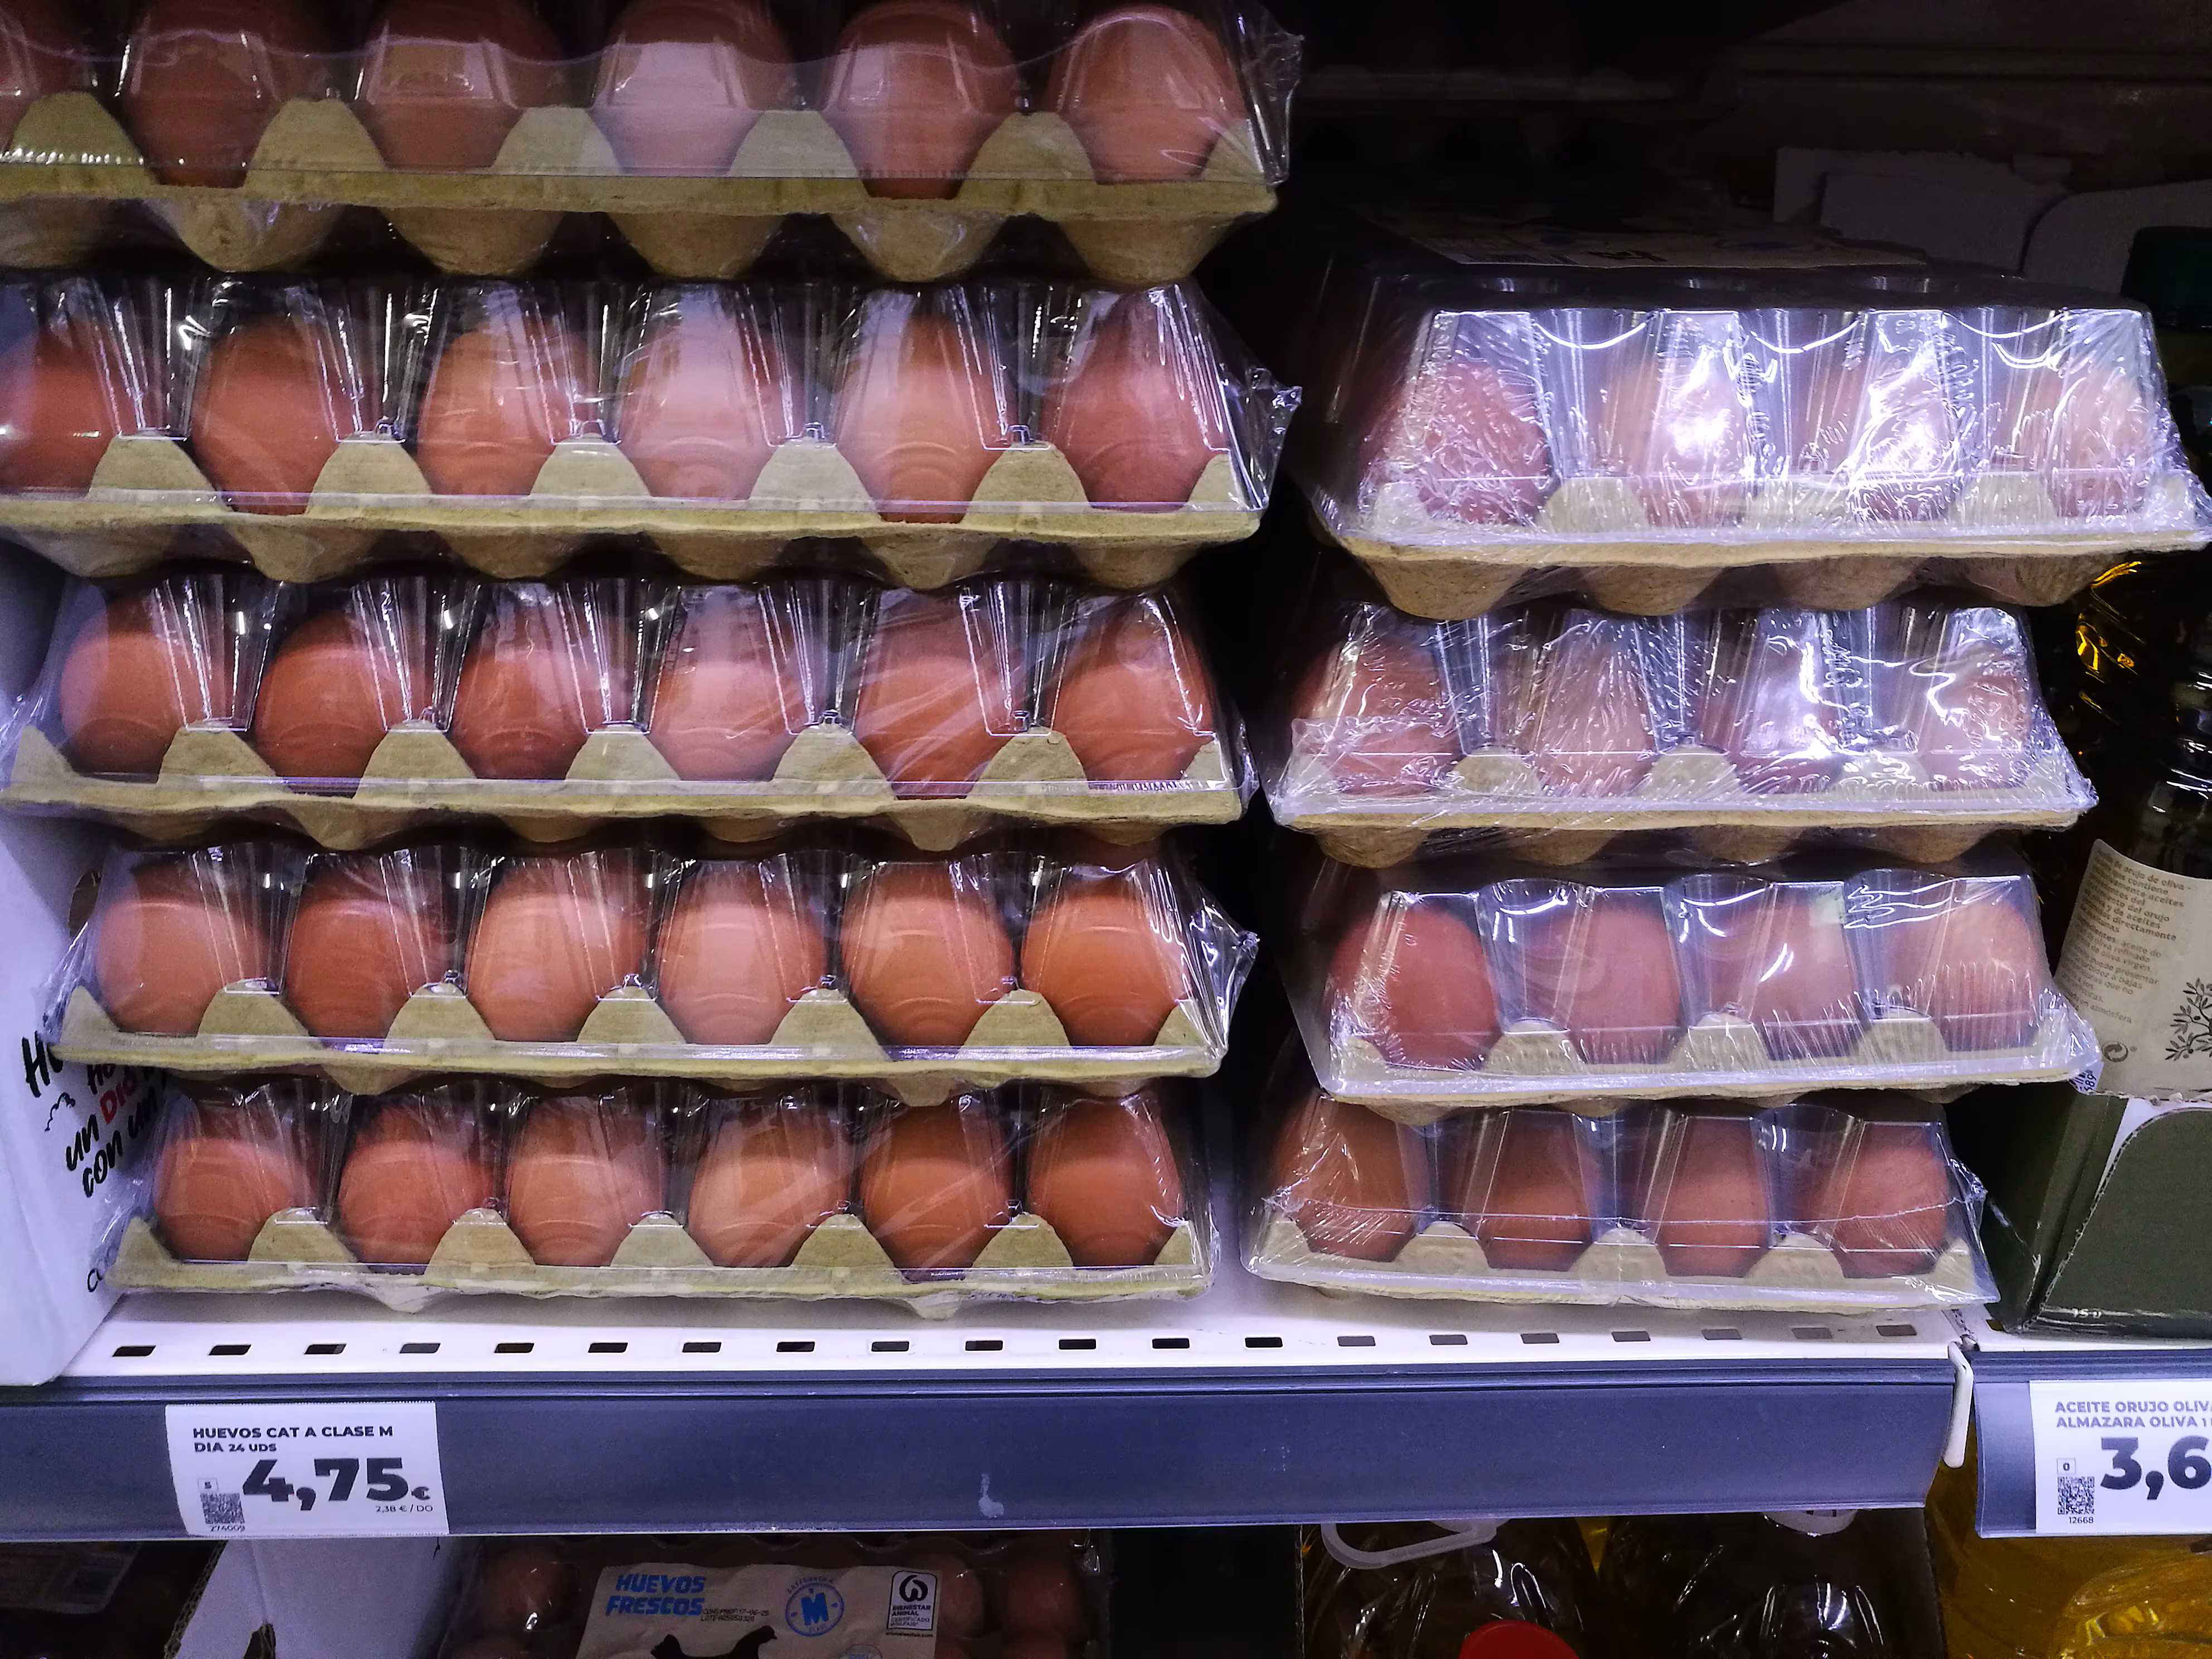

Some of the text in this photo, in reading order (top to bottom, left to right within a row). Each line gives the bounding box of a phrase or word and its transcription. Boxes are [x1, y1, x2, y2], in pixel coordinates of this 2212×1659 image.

[2055, 1400, 2212, 1413] ACEITE ORUJO OLIV
[2056, 1417, 2145, 1428] ALMAZARA
[2150, 1416, 2198, 1428] OLIVA
[193, 1425, 394, 1439] HUEVOS CAT A CLASE M
[193, 1442, 277, 1453] DIA 24 UDS
[242, 1457, 409, 1511] 4,75
[2069, 1516, 2094, 1525] 12668
[615, 1574, 706, 1594] HUEVOS
[606, 1595, 705, 1616] FRESCOS
[801, 1592, 829, 1626] M
